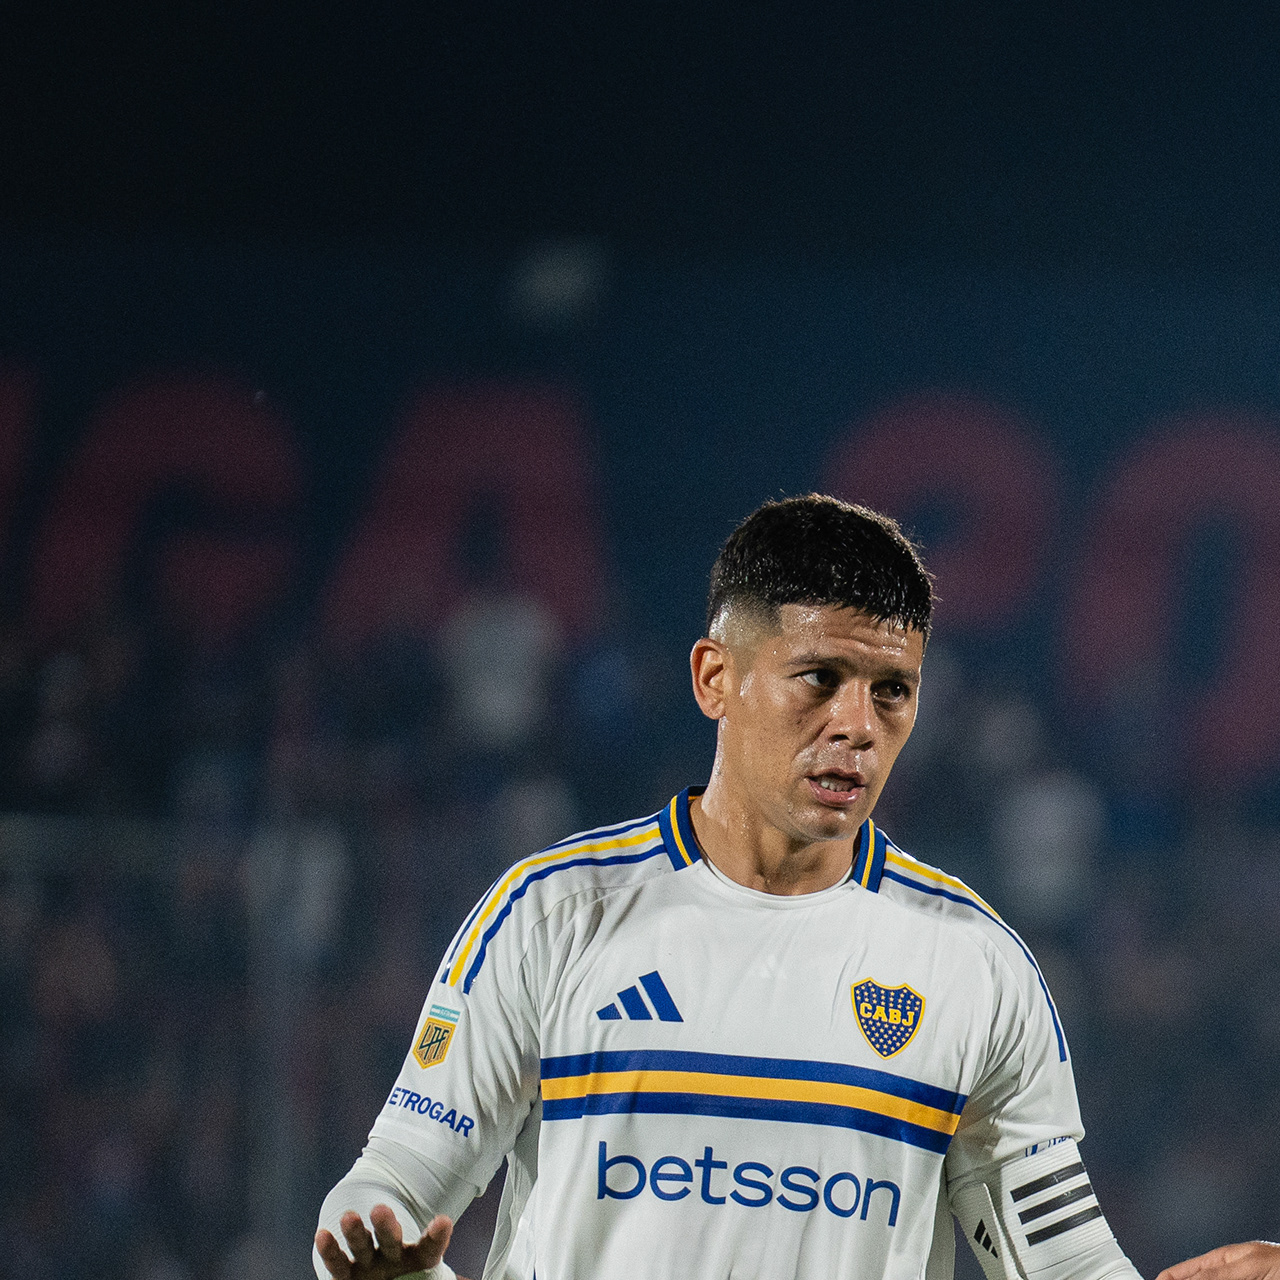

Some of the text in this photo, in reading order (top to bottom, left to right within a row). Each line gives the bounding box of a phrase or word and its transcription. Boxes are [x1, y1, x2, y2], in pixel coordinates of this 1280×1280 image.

[860, 1002, 914, 1027] CABJ
[388, 1087, 475, 1138] ETROGAR
[597, 1141, 901, 1227] betsson
